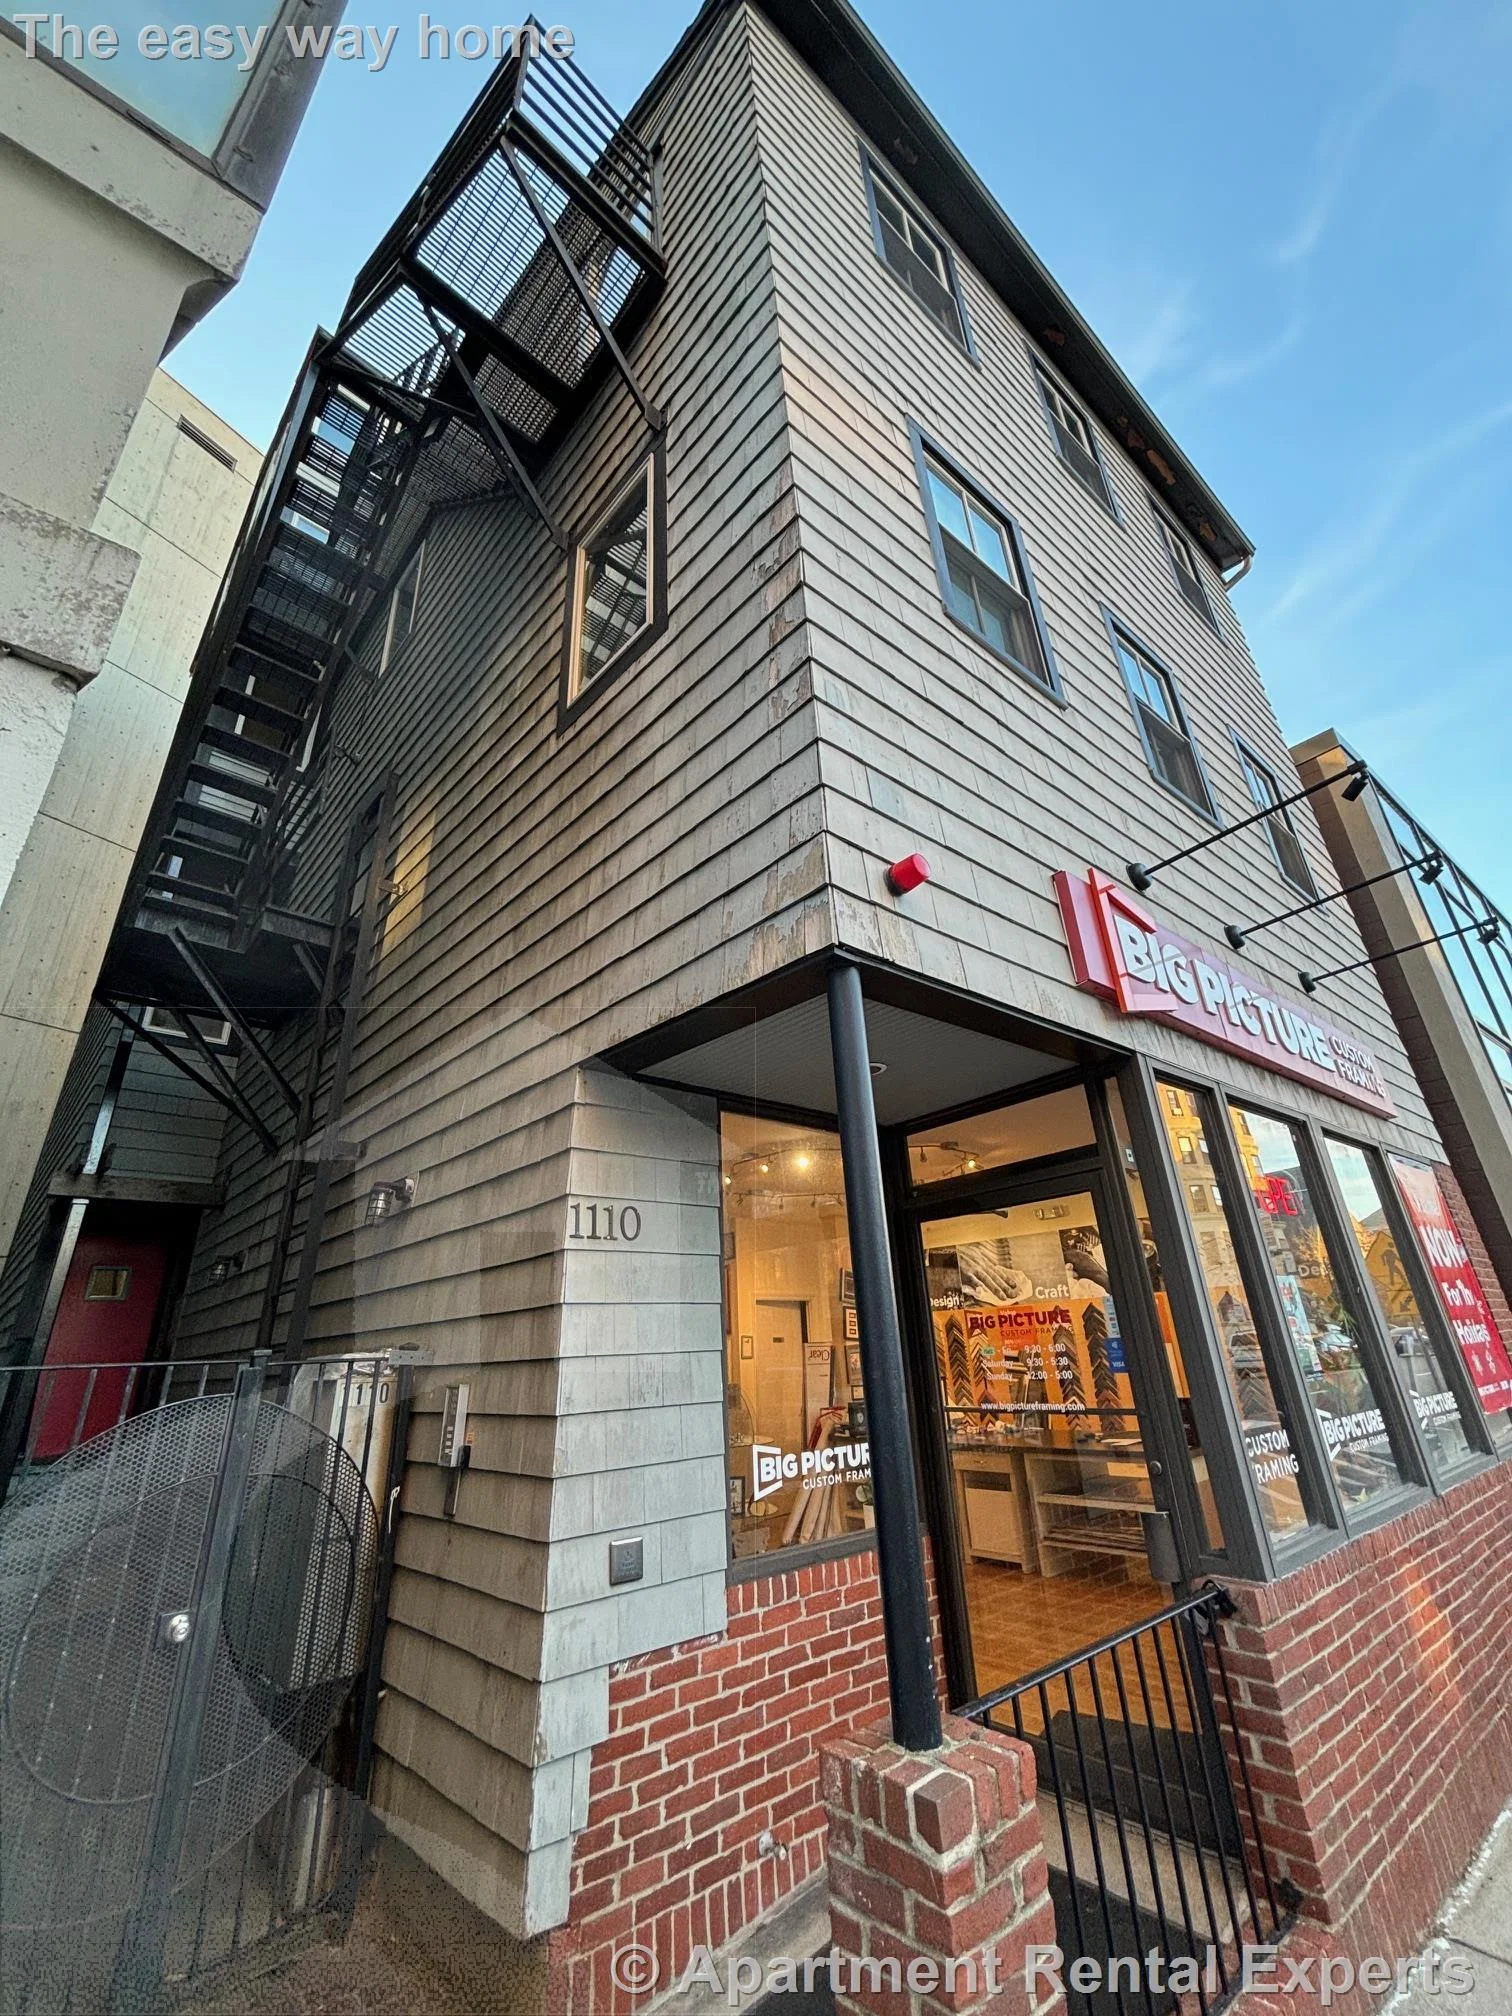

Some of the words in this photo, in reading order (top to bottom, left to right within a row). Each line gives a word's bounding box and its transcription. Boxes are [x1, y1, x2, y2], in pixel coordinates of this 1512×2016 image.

[1113, 914, 1199, 1005] BIG
[1191, 959, 1336, 1073] PICTURE
[1329, 1035, 1375, 1073] CUSTOM
[1334, 1059, 1387, 1099] FRAMING
[569, 1202, 641, 1241] 1110
[1419, 1225, 1464, 1268] NOW
[1035, 1284, 1070, 1299] Craft
[1441, 1282, 1463, 1307] For
[969, 1314, 996, 1330] BIG
[998, 1309, 1072, 1328] PICTURE
[1000, 1328, 1032, 1337] CUSTOM
[1051, 1356, 1069, 1366] 5:30
[1112, 1360, 1126, 1368] VISA
[1055, 1370, 1073, 1380] 5:00
[343, 1382, 390, 1405] 10
[1413, 1396, 1431, 1418] BIG
[1425, 1391, 1458, 1415] PICTURE
[981, 1401, 1085, 1413] www.bigpictureframing.com
[1322, 1418, 1346, 1444] BIG
[1340, 1408, 1386, 1440] PICTURE
[1245, 1429, 1290, 1458] CUSTOM
[760, 1453, 799, 1482] BIG
[801, 1442, 871, 1475] PICTUR
[1251, 1453, 1299, 1484] RAMING
[803, 1473, 842, 1490] CUSTOM
[846, 1467, 872, 1482] FRAM
